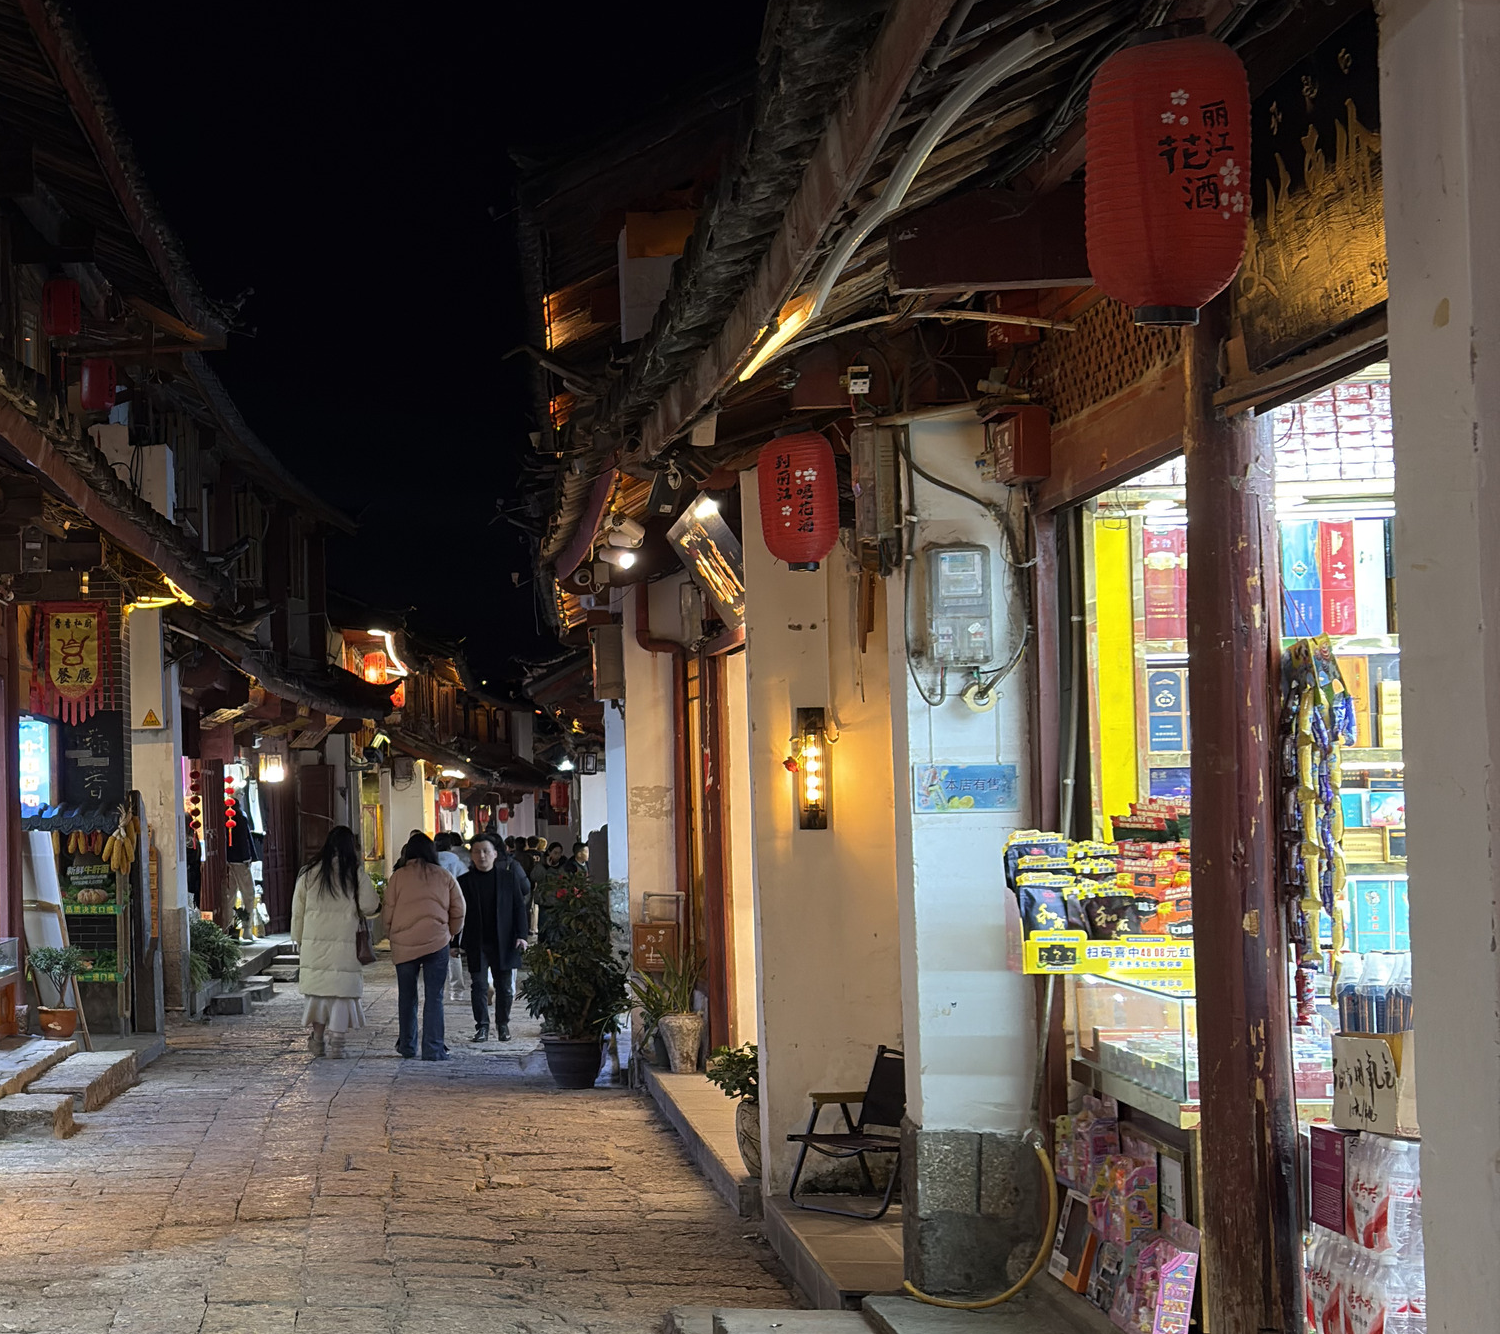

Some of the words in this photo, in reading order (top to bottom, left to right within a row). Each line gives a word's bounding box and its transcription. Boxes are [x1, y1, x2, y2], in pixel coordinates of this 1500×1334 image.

[1199, 99, 1235, 158] 丽江
[1157, 133, 1221, 210] 花酒
[775, 454, 792, 502] 到丽江
[796, 483, 815, 533] 喝花酒
[55, 667, 93, 684] 餐廳
[945, 777, 1001, 791] 本店有售
